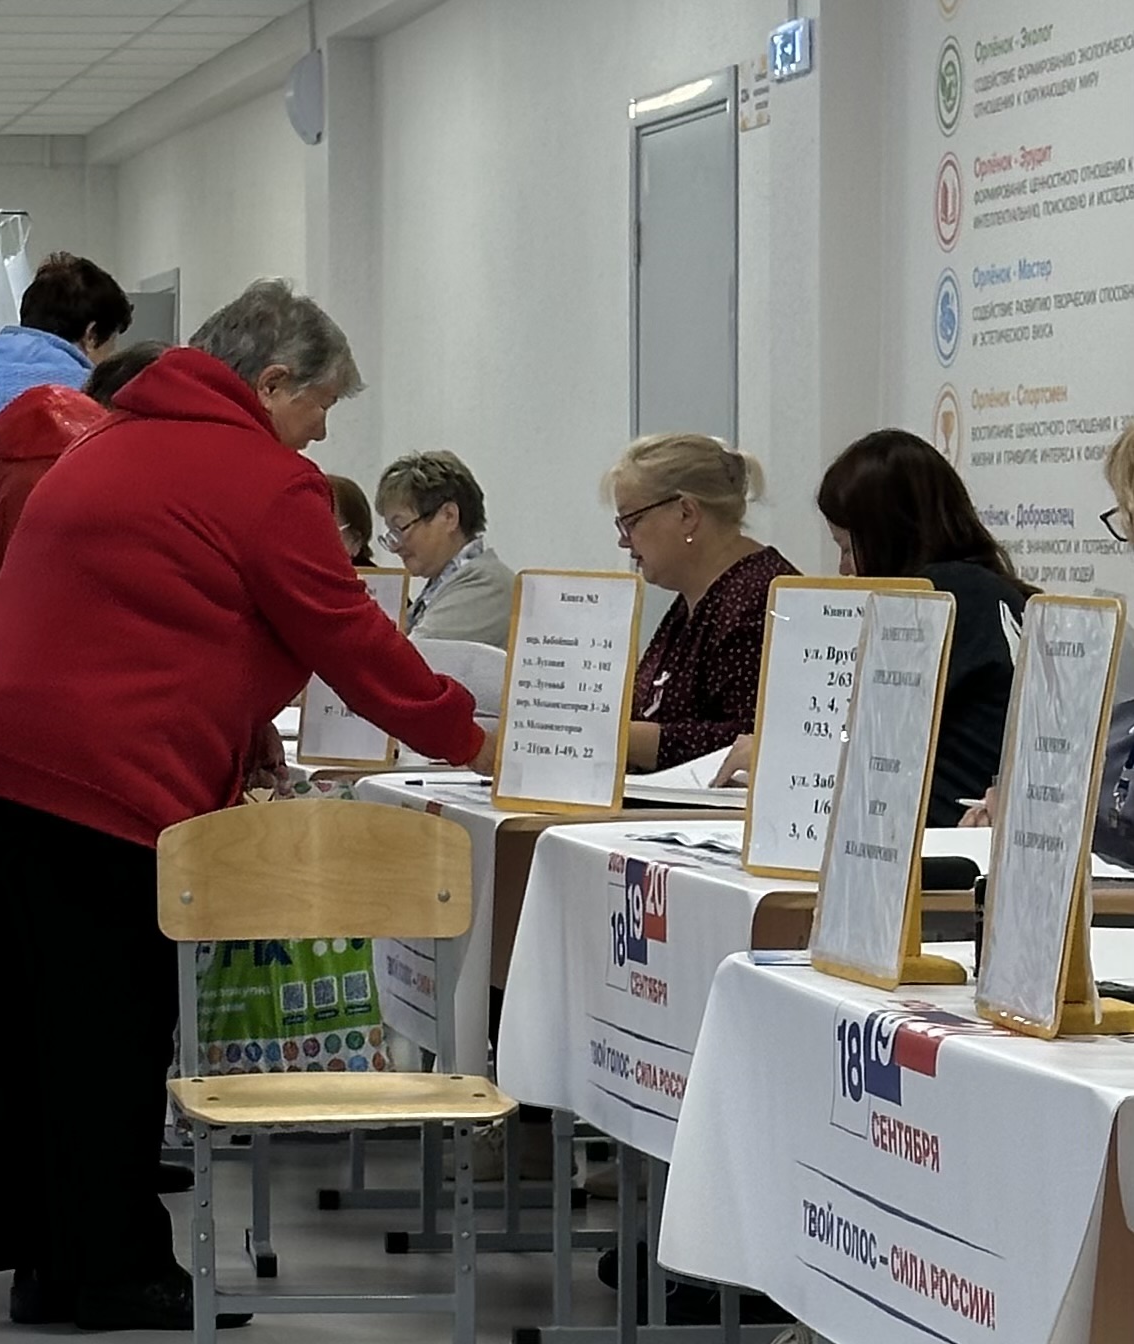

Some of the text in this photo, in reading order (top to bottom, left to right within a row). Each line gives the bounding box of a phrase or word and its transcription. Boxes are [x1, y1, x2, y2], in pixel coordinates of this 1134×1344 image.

[975, 35, 1014, 64] Орлёнок
[1020, 23, 1053, 48] Эколог
[974, 153, 1012, 182] Орлёнок
[973, 264, 1011, 292] Орлёнок
[1018, 258, 1052, 282] Мастер
[1031, 323, 1053, 340] ВКУСА
[972, 387, 1010, 415] Орлёнок
[1017, 383, 1068, 409] Спортсмен
[1016, 503, 1075, 531] Доброволец
[560, 592, 584, 603] Книга
[823, 605, 853, 618] Книга
[590, 638, 596, 648] 3
[602, 639, 612, 649] 24
[582, 659, 591, 670] 32
[803, 646, 858, 666] ул. Вруб
[578, 681, 586, 692] 11
[592, 682, 603, 693] 25
[827, 672, 853, 687] 2/63
[809, 697, 839, 714] 3, 4,
[803, 722, 833, 739] 9/33,
[512, 741, 519, 752] 3
[582, 748, 594, 758] 22
[789, 773, 835, 790] ул. Заб
[813, 799, 831, 815] 1/6
[788, 824, 817, 841] 3, 6,
[645, 864, 666, 917] 20
[627, 883, 644, 941] 19
[611, 911, 626, 967] 18
[630, 970, 668, 1007] СЕНТЯБРЯ
[607, 1044, 630, 1081] ГОЛОС
[635, 1059, 658, 1092] СИЛА
[837, 1018, 863, 1102] 18
[871, 1110, 940, 1173] СЕНТЯБРЯ
[802, 1198, 835, 1247] ТВОЙ
[836, 1210, 877, 1270] ГОЛОС
[890, 1244, 928, 1298] СИЛА
[930, 1262, 996, 1332] РОССИИ!
